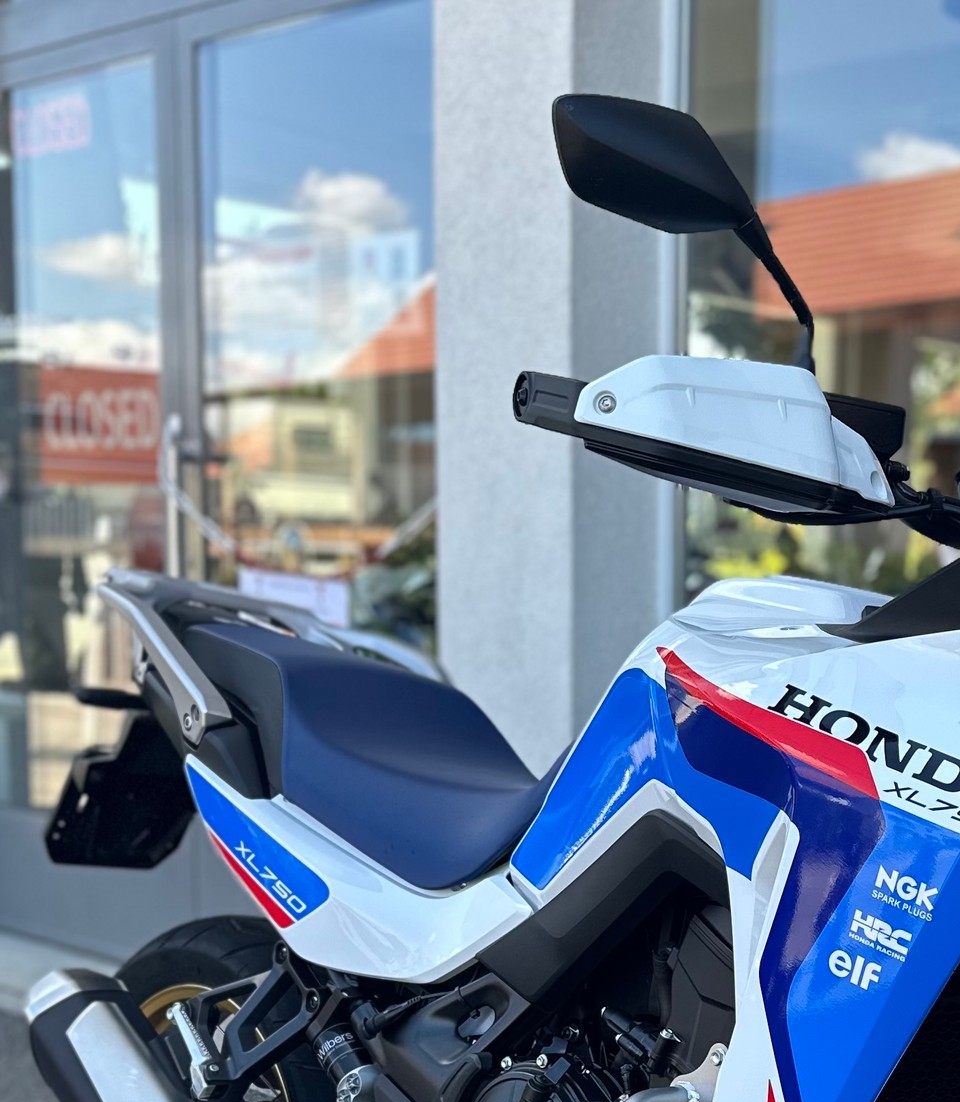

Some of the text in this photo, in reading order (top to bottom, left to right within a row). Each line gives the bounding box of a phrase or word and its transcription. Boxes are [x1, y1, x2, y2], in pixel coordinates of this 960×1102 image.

[44, 386, 159, 452] CLOSED
[233, 840, 307, 914] XL750
[874, 864, 939, 912] NGK
[871, 889, 932, 921] SPARK PLUGS
[848, 931, 906, 962] HONDA RACING
[850, 909, 913, 956] HRC
[828, 949, 883, 990] elf
